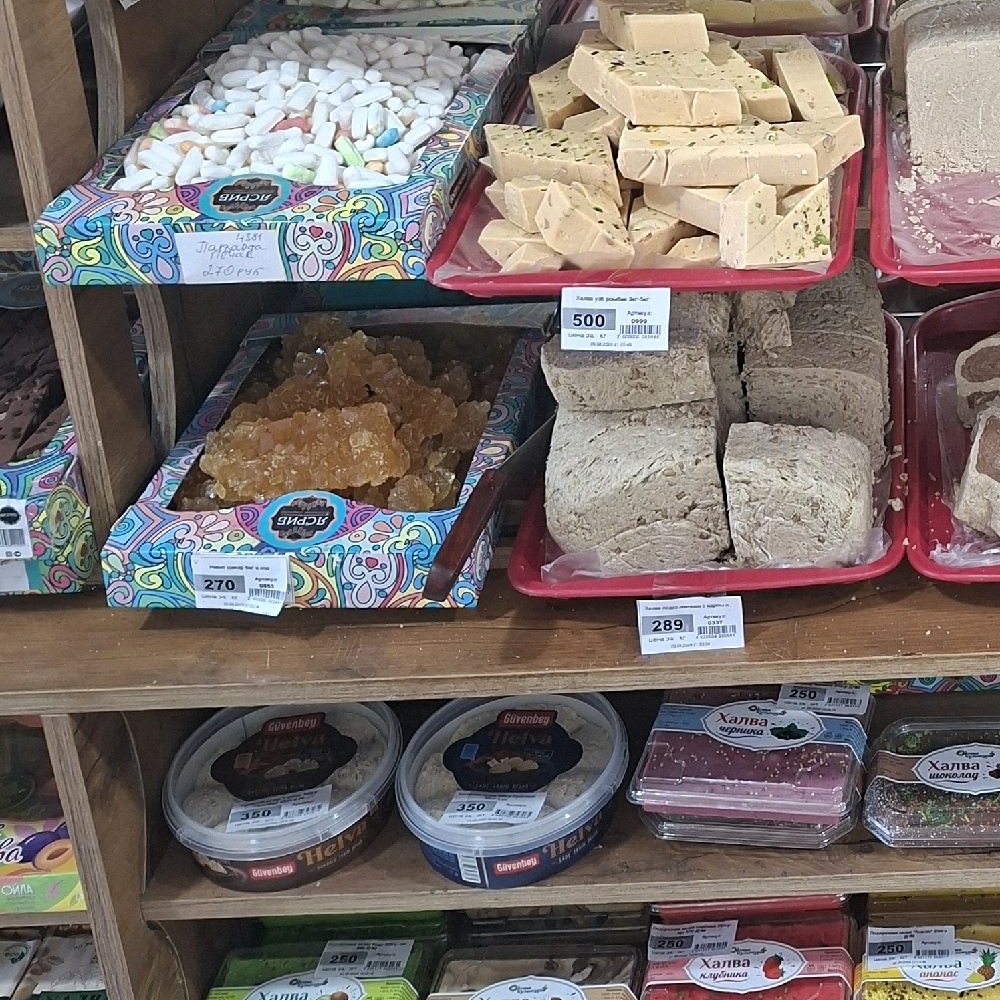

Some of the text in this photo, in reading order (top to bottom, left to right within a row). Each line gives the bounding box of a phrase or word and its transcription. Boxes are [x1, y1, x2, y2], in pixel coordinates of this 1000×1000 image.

[218, 193, 272, 202] ЯСРИБ
[202, 264, 266, 277] 270 руб
[572, 313, 605, 327] 500
[276, 516, 329, 526] ЯСРИБ
[204, 579, 235, 591] 270
[651, 619, 683, 632] 289
[788, 689, 817, 699] 250
[267, 717, 317, 732] Güvenbey
[503, 713, 550, 726] Güvenbey
[715, 712, 768, 727] Халва
[718, 725, 764, 737] черника
[927, 760, 981, 772] Халва
[928, 771, 979, 780] шоколад
[455, 801, 487, 813] 350
[240, 809, 272, 821] 350
[542, 811, 603, 860] Helva
[296, 820, 368, 867] Helva
[496, 856, 538, 873] Güvenbey
[251, 864, 294, 878] Güvenbey
[657, 939, 685, 949] 250
[877, 945, 904, 954] 250
[329, 955, 357, 965] 250
[699, 957, 751, 969] Халва
[699, 969, 748, 980] клубника
[918, 970, 959, 979] ананас
